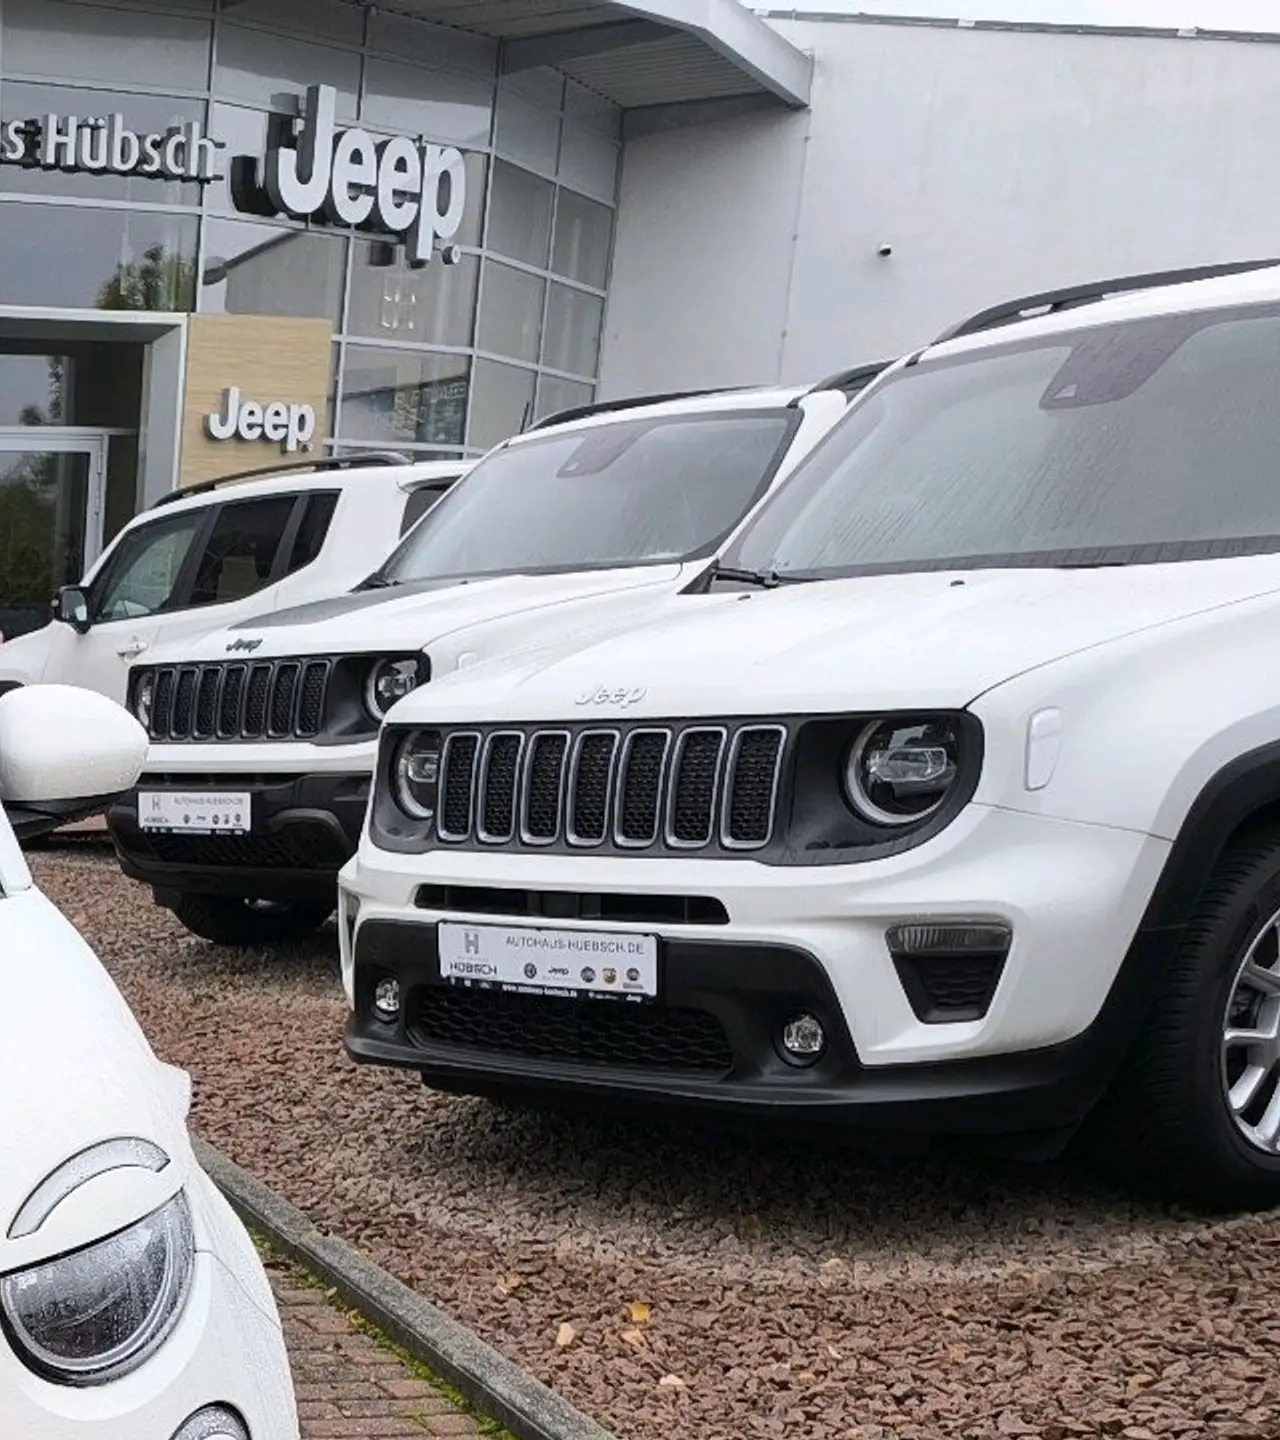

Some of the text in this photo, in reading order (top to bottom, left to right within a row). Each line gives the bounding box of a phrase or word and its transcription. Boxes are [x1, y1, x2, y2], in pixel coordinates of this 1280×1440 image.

[44, 112, 215, 178] Hübsch
[276, 84, 466, 261] Jeep
[208, 386, 316, 452] Jeep
